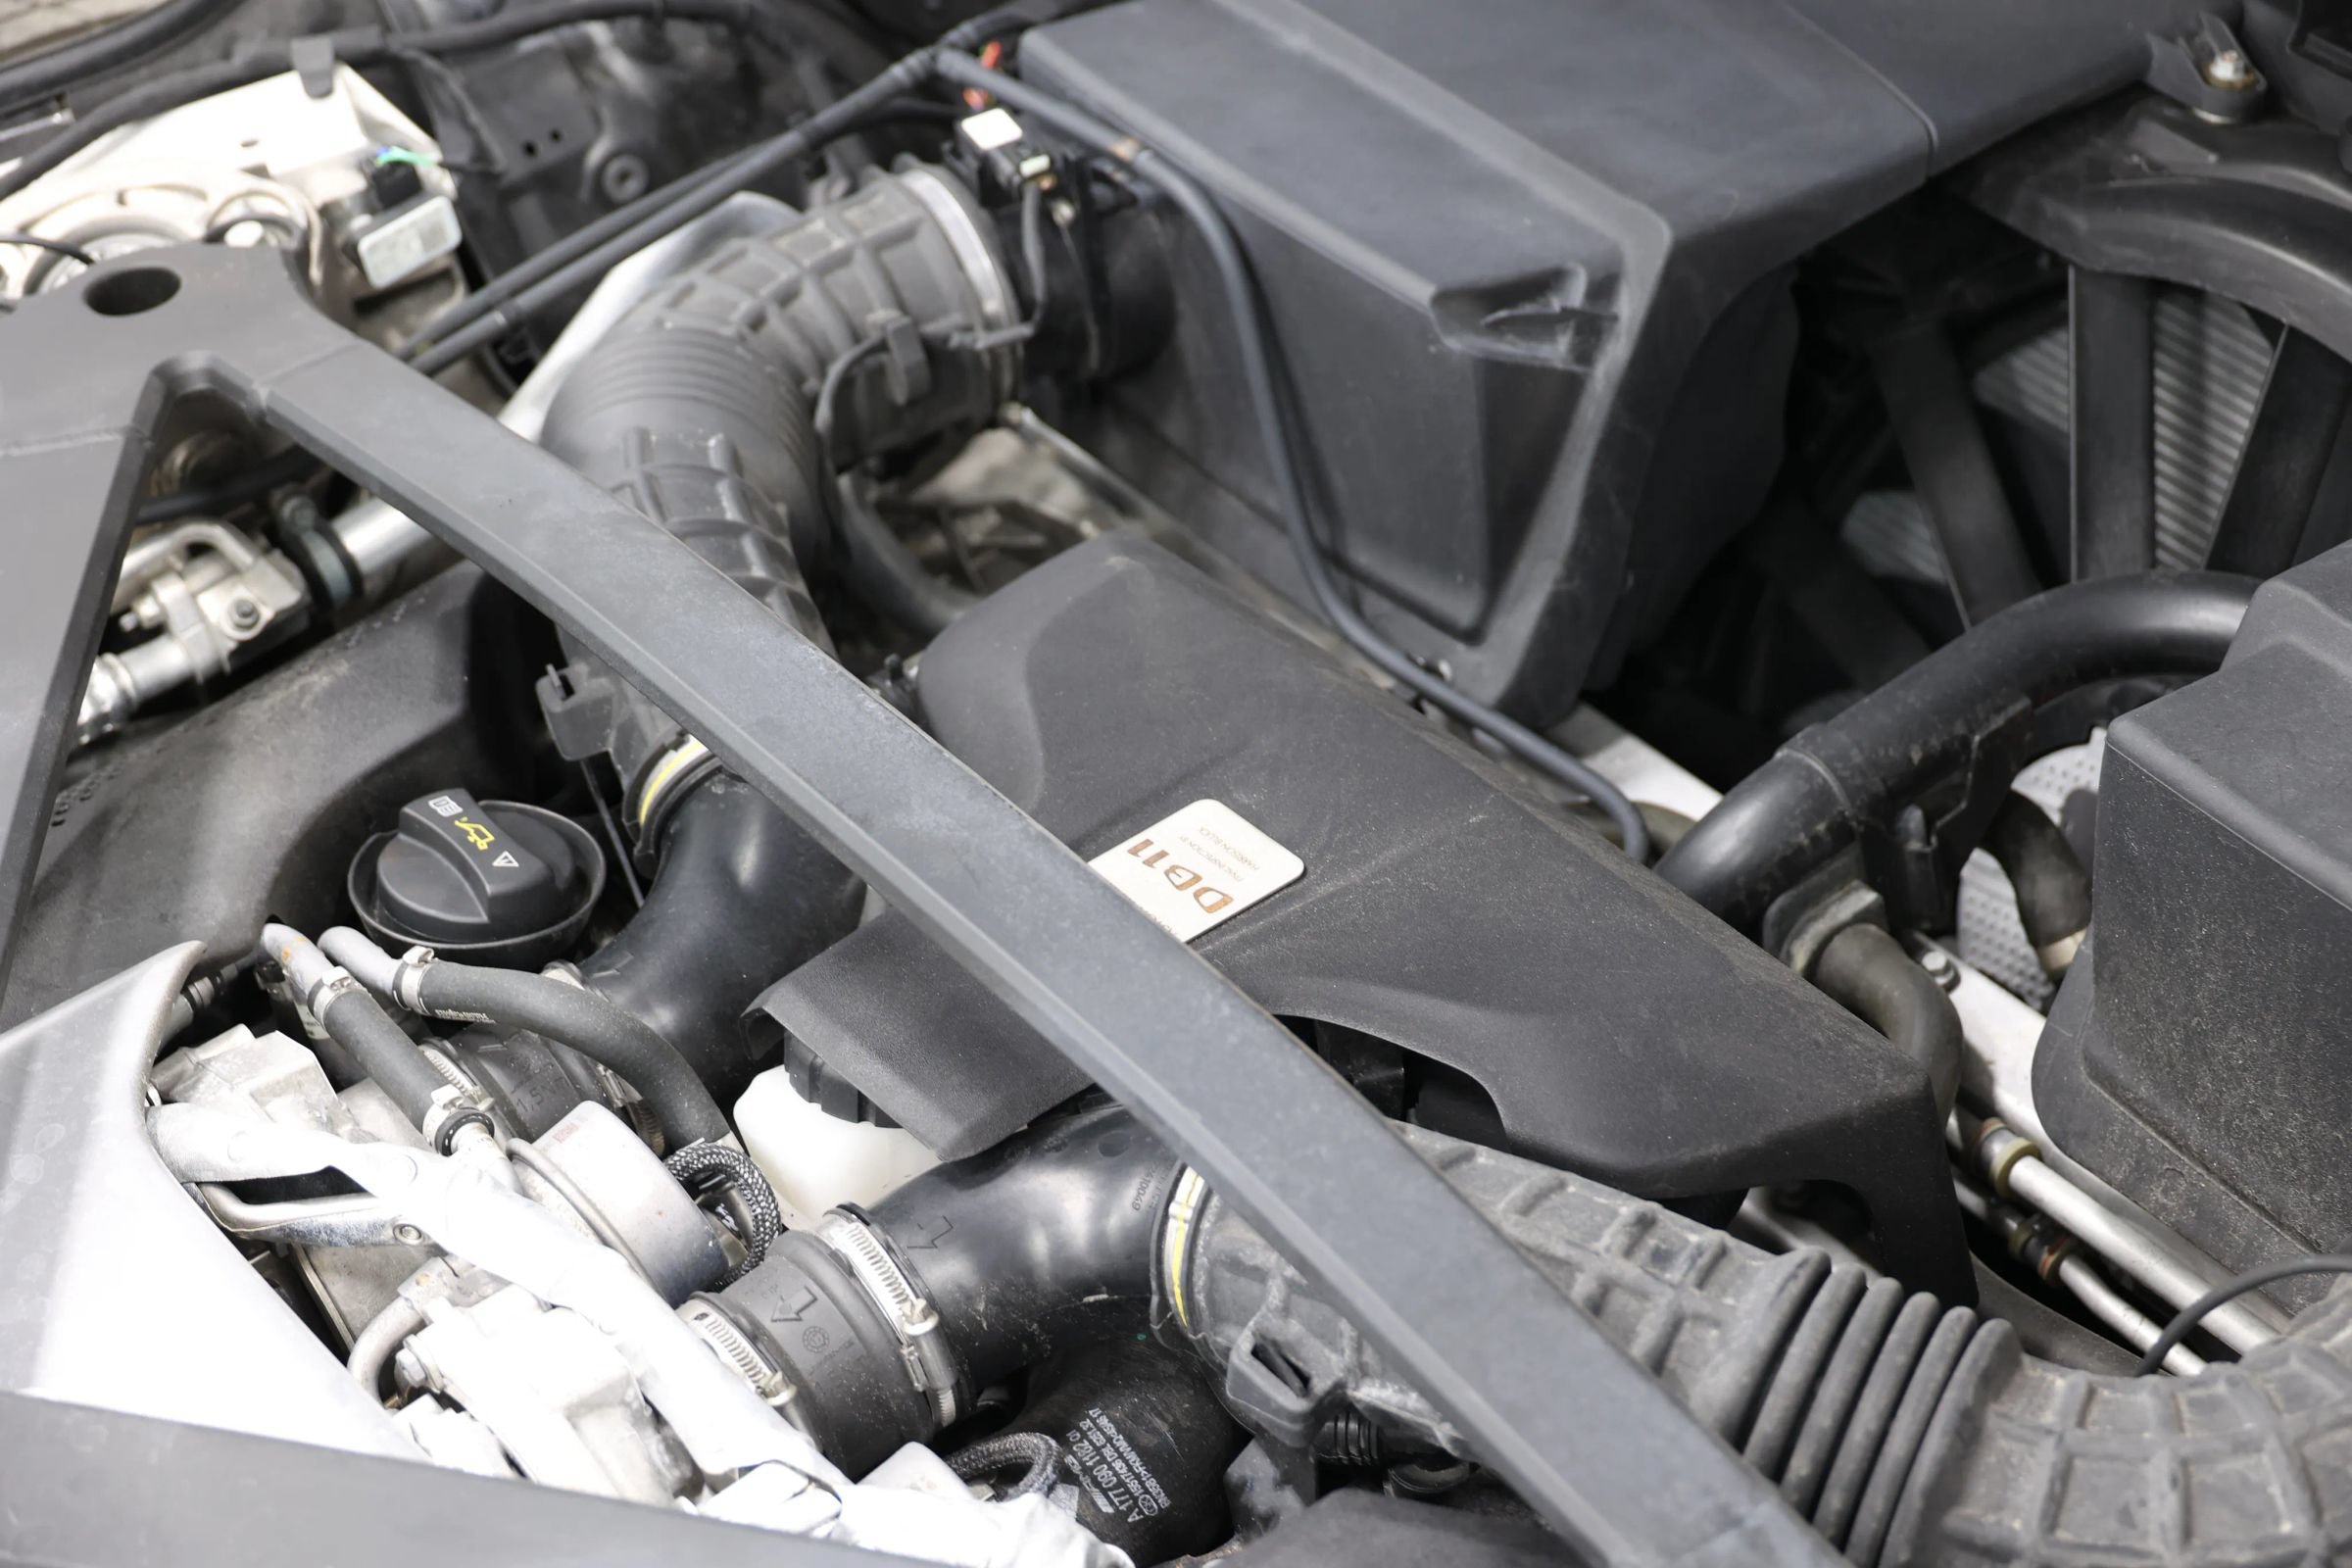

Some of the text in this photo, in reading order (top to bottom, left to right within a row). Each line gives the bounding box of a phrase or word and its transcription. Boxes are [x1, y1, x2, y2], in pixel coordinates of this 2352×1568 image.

[1127, 839, 1234, 913] DB11
[1072, 1439, 1100, 1466] 1182
[1093, 1464, 1117, 1488] 090
[1107, 1488, 1133, 1511] 177
[1127, 1508, 1144, 1522] A
